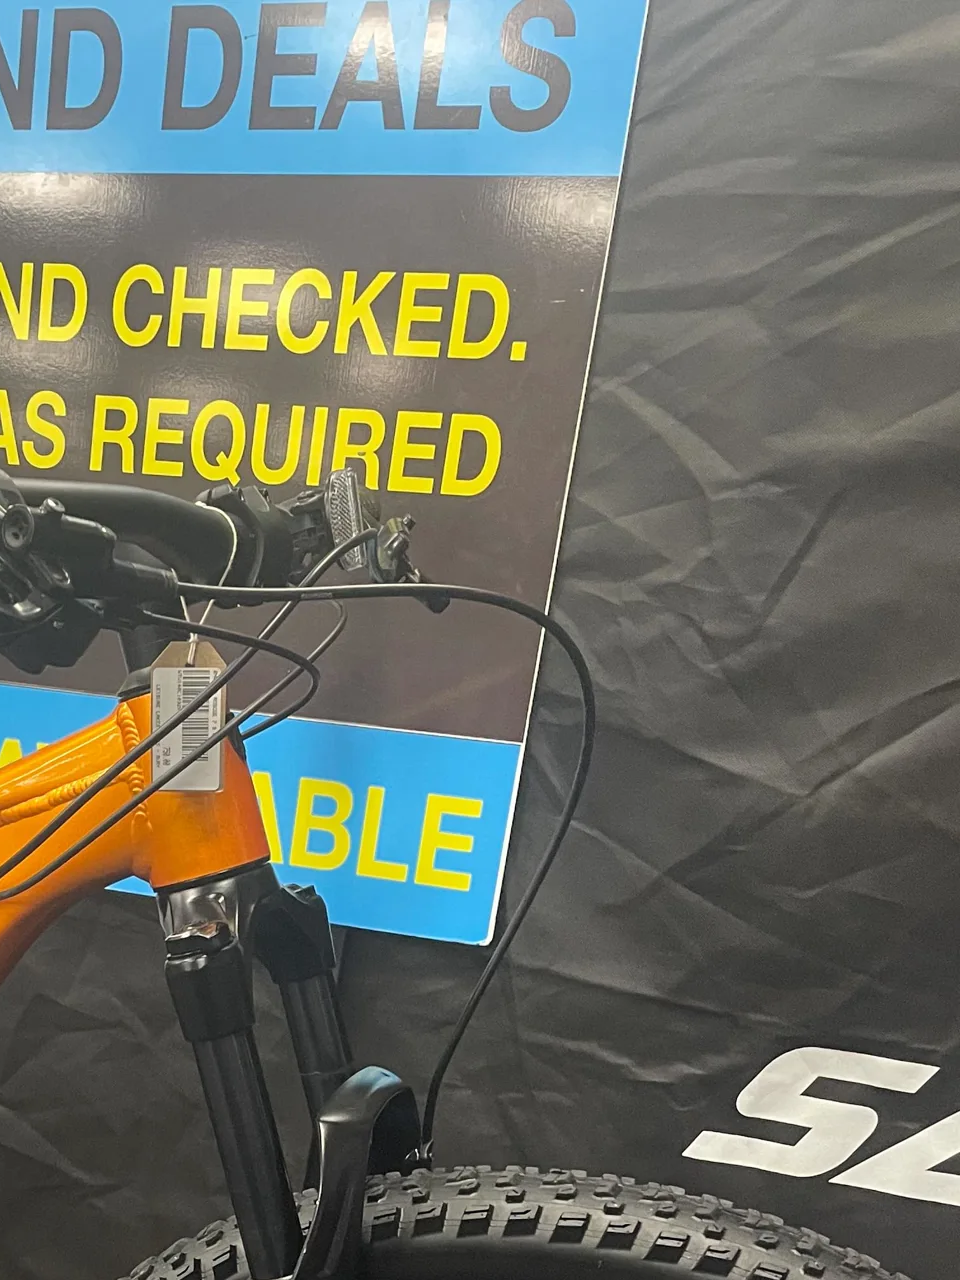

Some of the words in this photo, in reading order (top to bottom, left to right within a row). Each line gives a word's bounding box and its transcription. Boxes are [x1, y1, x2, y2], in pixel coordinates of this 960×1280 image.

[161, 0, 577, 133] DEALS
[111, 263, 527, 361] CHECKED.
[89, 394, 502, 497] REQUIRED
